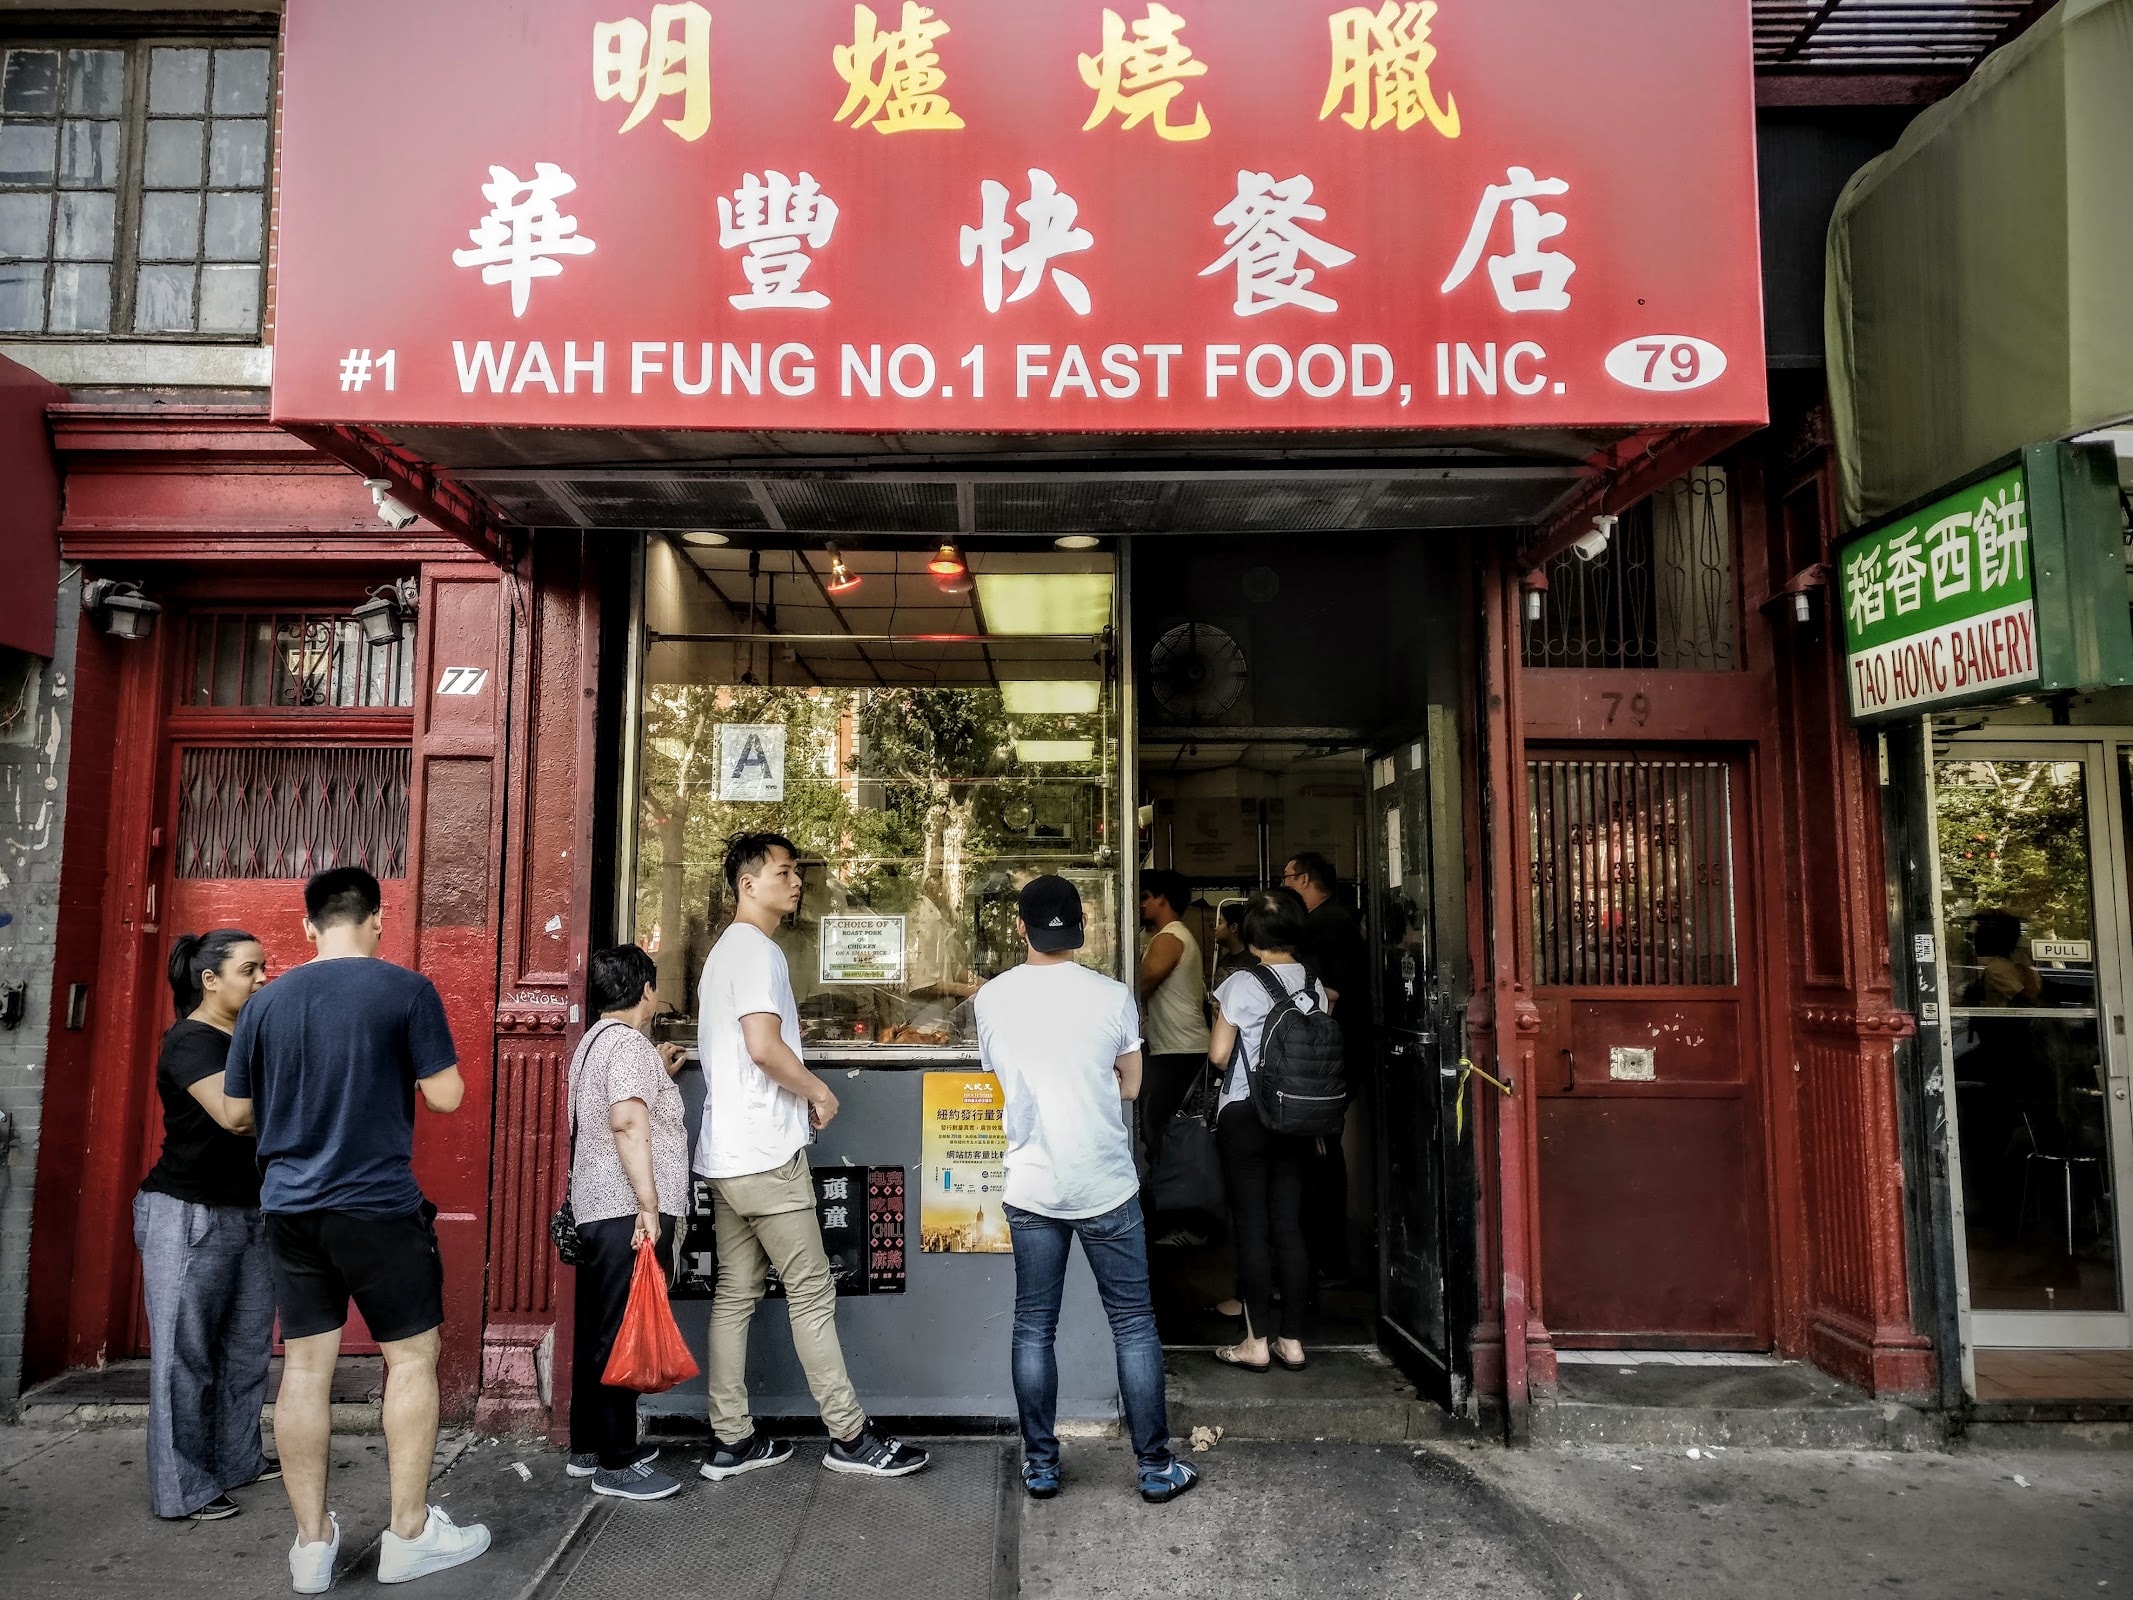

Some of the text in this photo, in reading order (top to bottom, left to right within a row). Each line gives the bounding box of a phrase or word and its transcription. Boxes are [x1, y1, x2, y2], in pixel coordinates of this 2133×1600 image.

[452, 162, 1576, 318] 華豐快餐店
[339, 348, 396, 392] #1
[452, 341, 1566, 407] WAH FUNG NO.1 FAST FOOD, INC.
[1635, 345, 1700, 383] 79
[1848, 482, 2028, 636] 稻香西餅
[1855, 653, 1889, 709] TAO
[1951, 608, 2034, 688] BAKERY
[441, 668, 486, 693] 77
[1601, 691, 1651, 727] 79
[731, 734, 773, 778] A
[837, 920, 889, 928] CHOICE OF
[2044, 944, 2080, 956] PULL
[871, 1222, 904, 1238] CHILL
